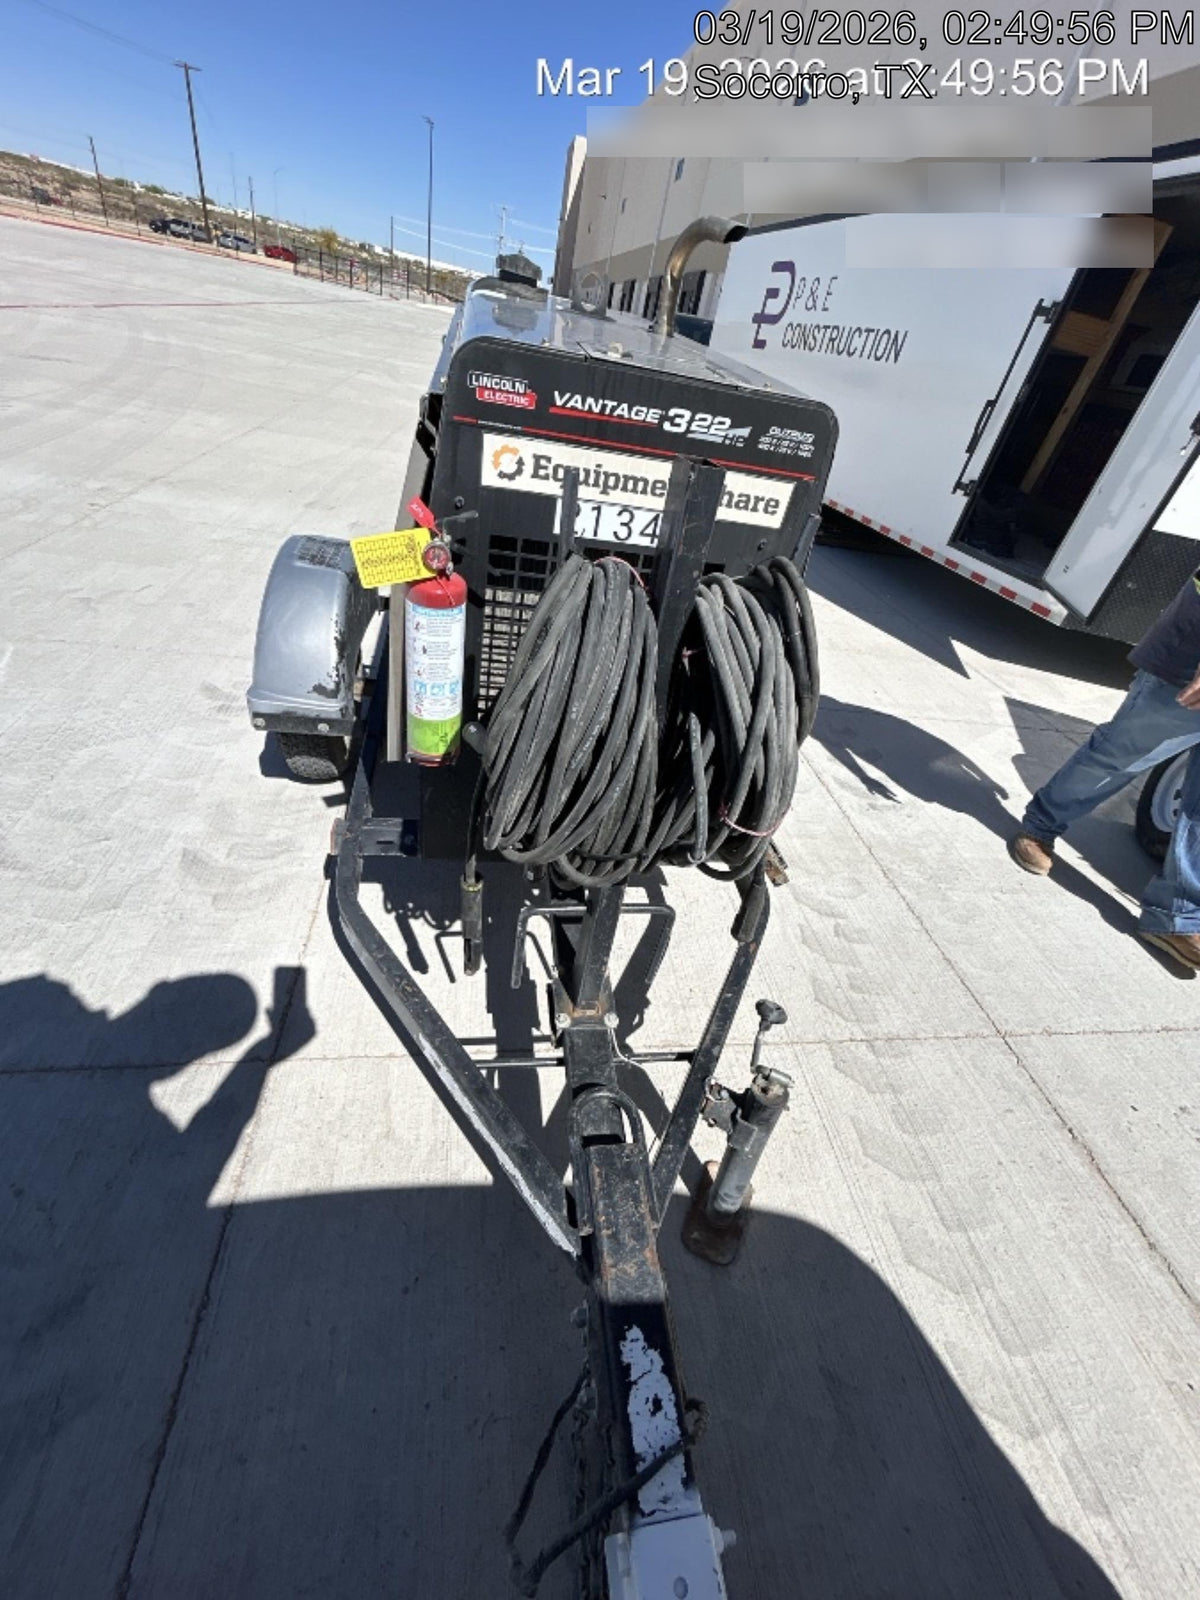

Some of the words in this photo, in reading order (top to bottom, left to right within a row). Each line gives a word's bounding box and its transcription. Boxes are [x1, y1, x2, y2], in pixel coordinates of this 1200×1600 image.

[792, 276, 807, 309] P
[804, 276, 821, 312] &
[781, 322, 909, 364] CONSTRUCTION
[471, 374, 526, 394] LINCOLN
[484, 390, 530, 406] ELECTRIC
[553, 391, 662, 424] VANTAGE
[662, 407, 732, 436] 322
